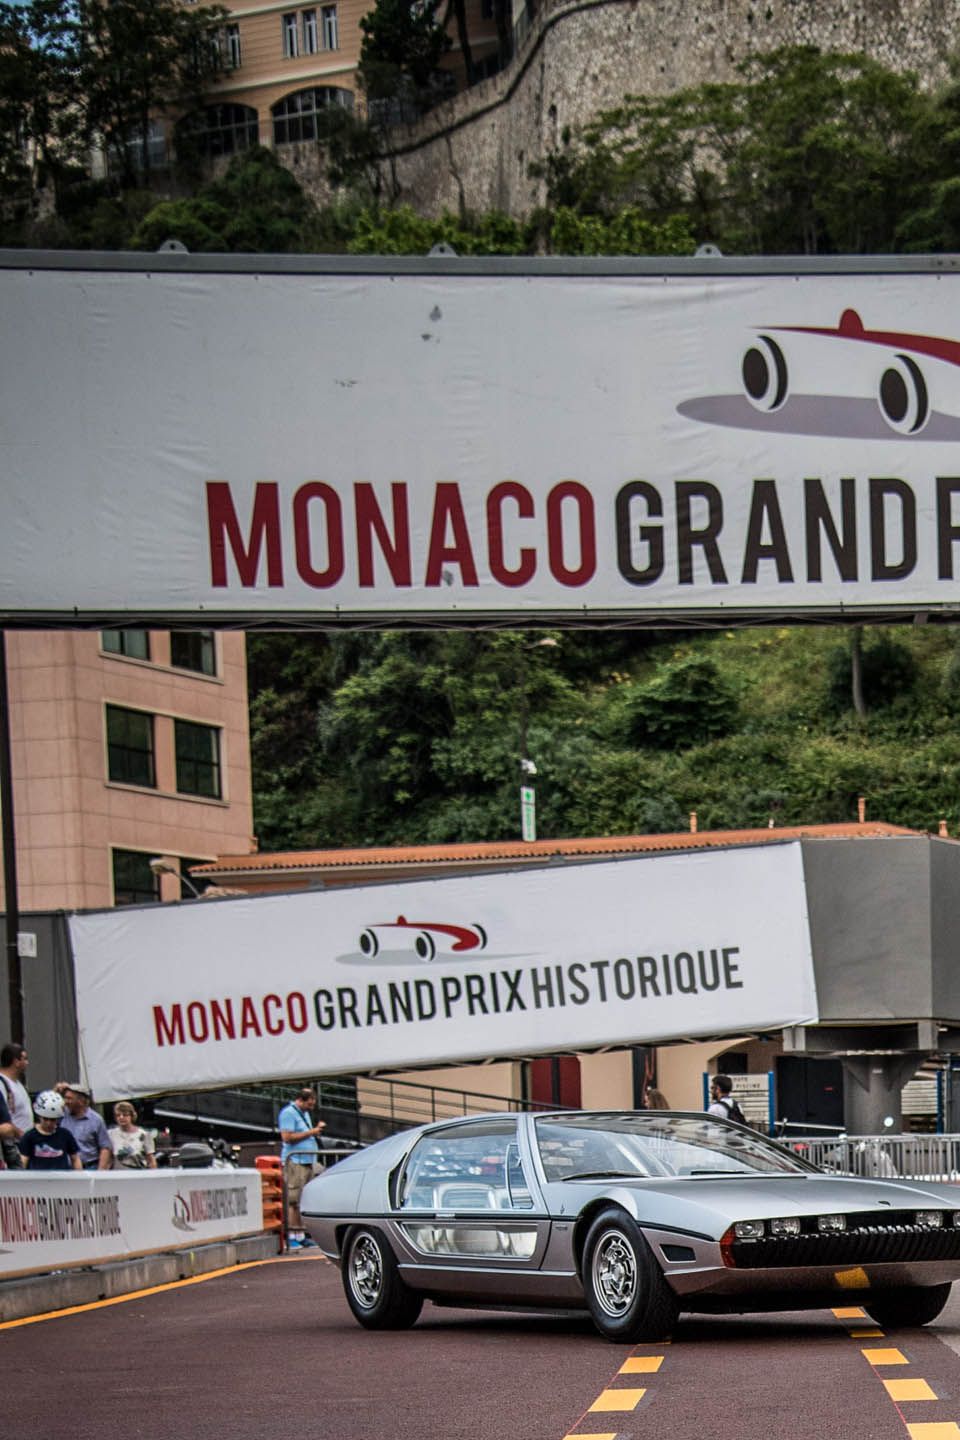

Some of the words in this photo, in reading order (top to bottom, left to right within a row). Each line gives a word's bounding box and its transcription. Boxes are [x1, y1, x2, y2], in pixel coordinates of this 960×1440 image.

[204, 480, 597, 590] MONACO
[614, 479, 918, 587] GRAND
[153, 991, 308, 1047] MONACO
[313, 979, 437, 1031] GRAND
[440, 968, 527, 1020] PRIX
[531, 946, 744, 1009] HISTORIQUE
